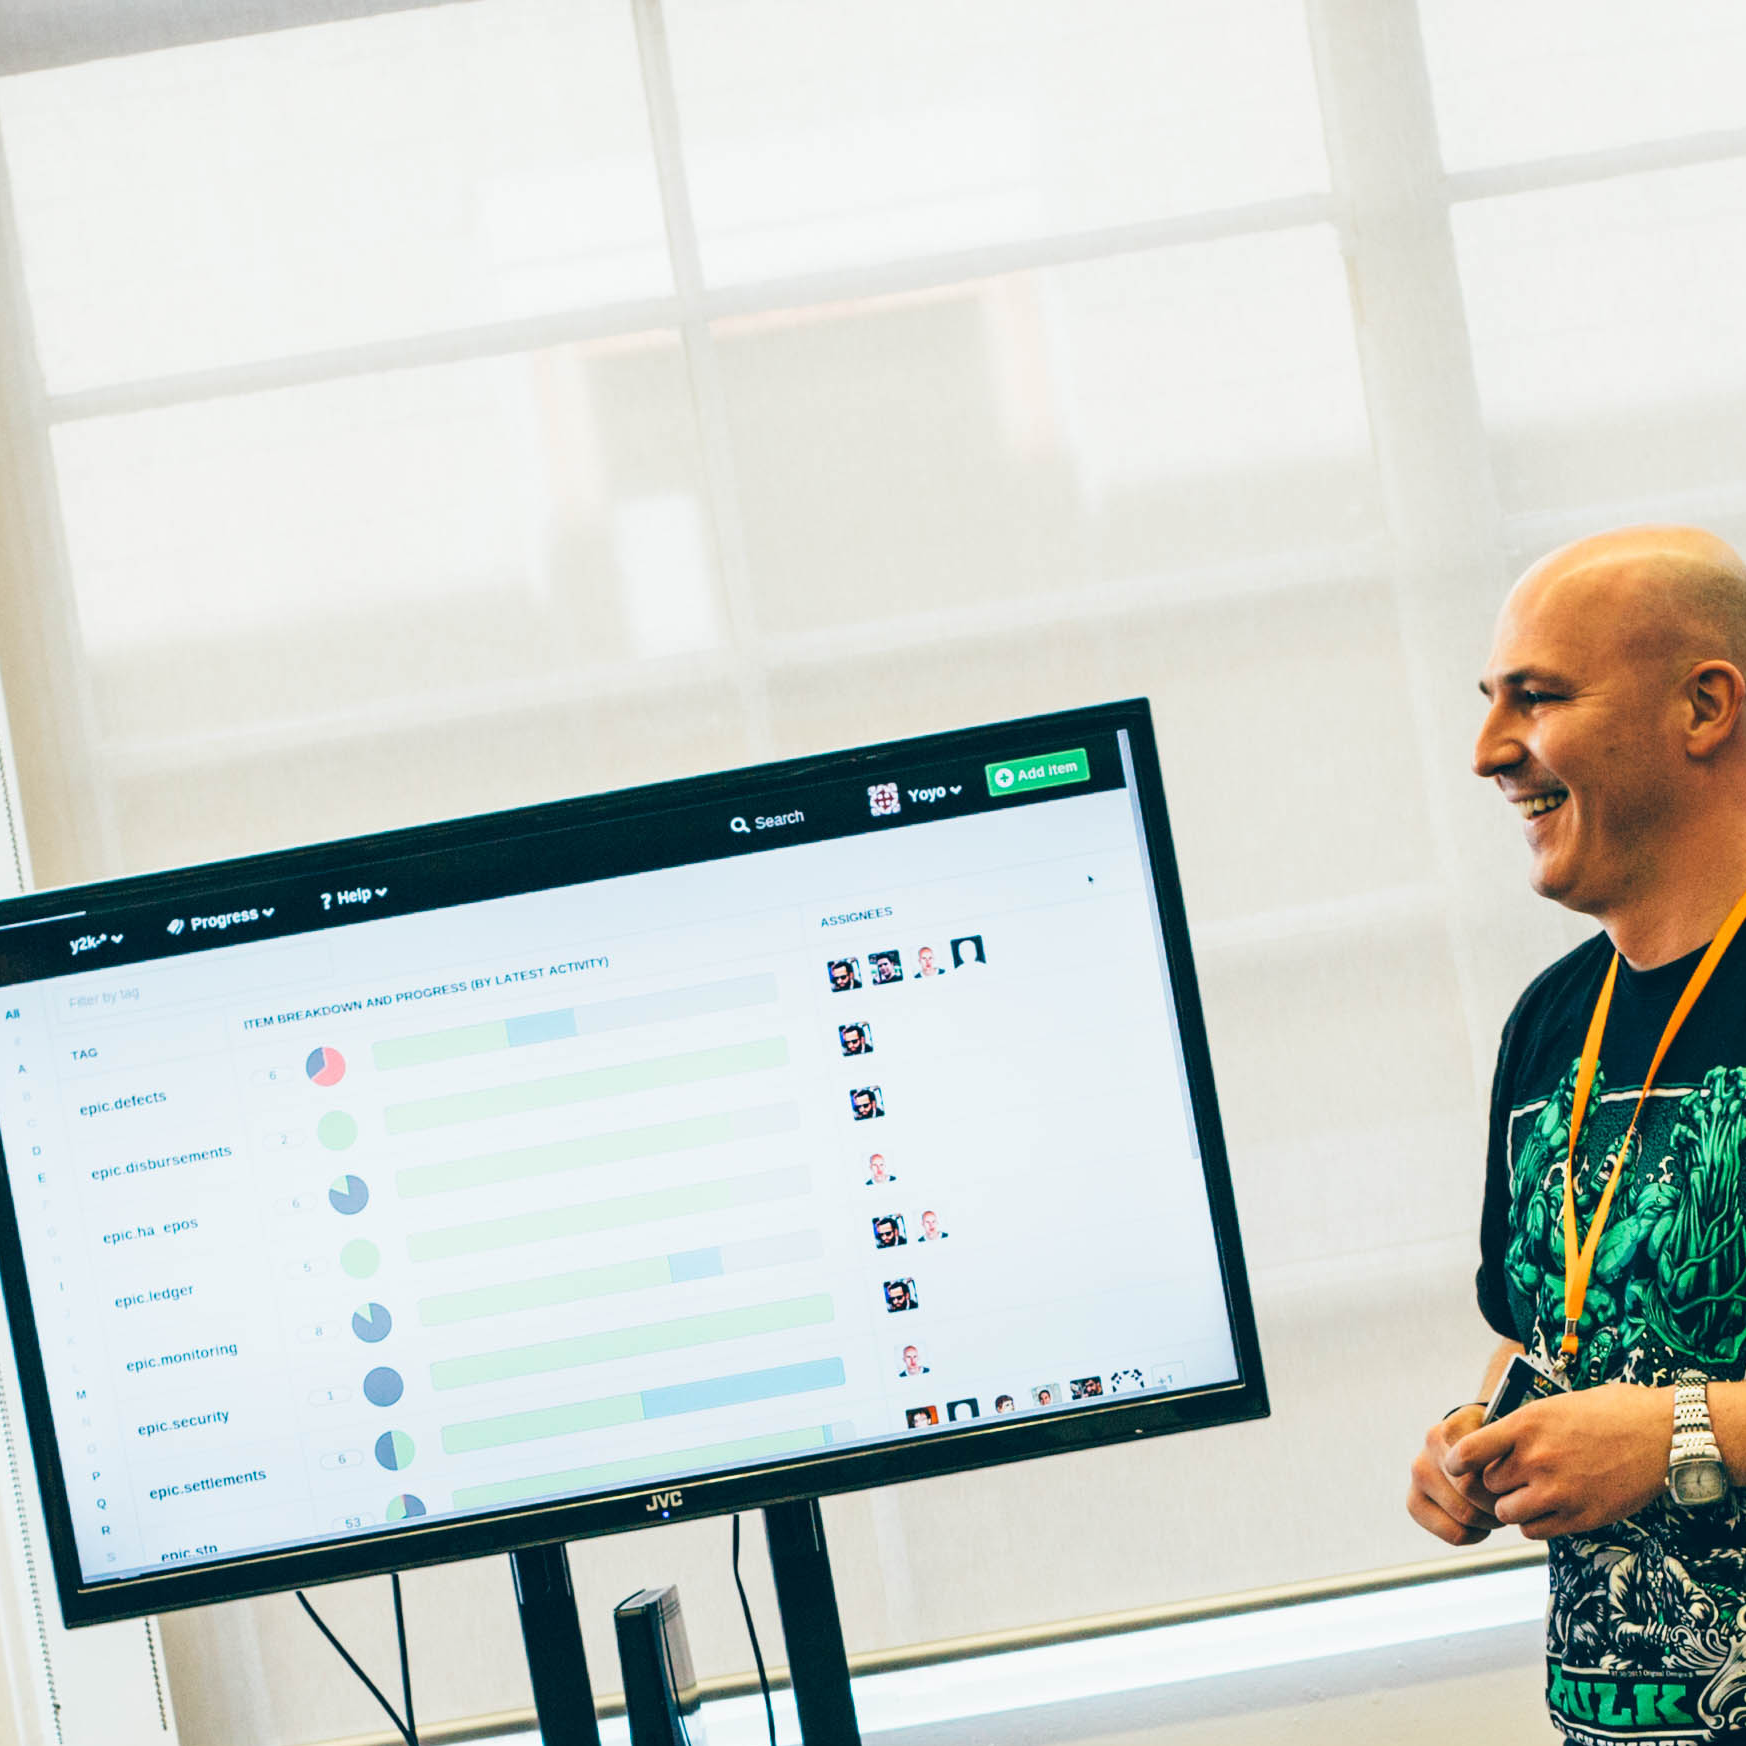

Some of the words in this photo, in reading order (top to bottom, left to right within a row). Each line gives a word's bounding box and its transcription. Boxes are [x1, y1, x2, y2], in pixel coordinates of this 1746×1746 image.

[1017, 767, 1045, 783] Add
[1048, 760, 1078, 777] item
[907, 784, 947, 805] Yoyo
[754, 809, 805, 831] Search
[337, 887, 372, 908] Help
[190, 907, 259, 933] Progress
[819, 906, 894, 929] ASSIGNEES
[243, 1014, 275, 1031] ITEM
[277, 1000, 363, 1025] BREAKDOWN
[366, 994, 393, 1010] AND
[395, 980, 468, 1004] PROGRESS
[470, 974, 492, 993] (BY
[495, 967, 545, 985] LATEST
[549, 955, 610, 976] ACTIVITY)
[4, 1007, 21, 1021] All
[70, 1046, 99, 1061] TAG
[17, 1064, 27, 1074] A
[79, 1089, 167, 1117] epic.defects
[32, 1145, 42, 1156] D
[91, 1145, 233, 1181] epic.disbursements
[37, 1172, 46, 1183] E
[114, 1283, 194, 1310] epic.ledger
[125, 1341, 239, 1374] epic.monitoring
[76, 1389, 87, 1401] M
[137, 1409, 231, 1438] epic.security
[338, 1453, 347, 1465] 6
[92, 1471, 101, 1482] P
[149, 1467, 267, 1501] epic.settlements
[96, 1498, 107, 1511] Q
[645, 1490, 683, 1512] JVC
[101, 1525, 111, 1536] R
[344, 1516, 362, 1529] 53
[1549, 1664, 1695, 1726] HULK
